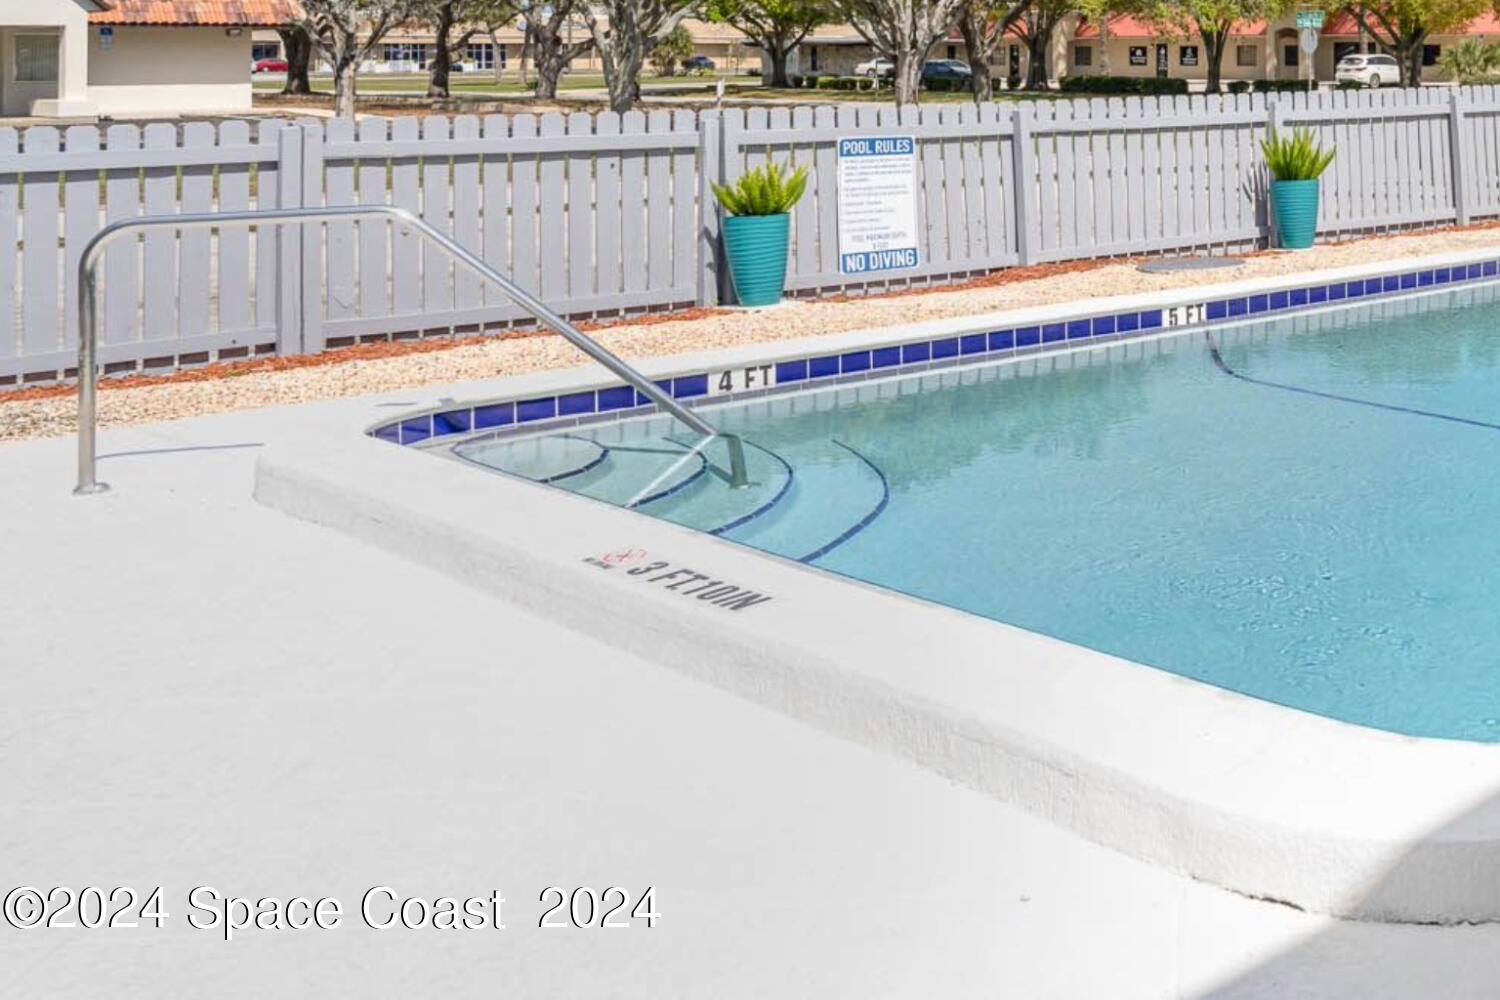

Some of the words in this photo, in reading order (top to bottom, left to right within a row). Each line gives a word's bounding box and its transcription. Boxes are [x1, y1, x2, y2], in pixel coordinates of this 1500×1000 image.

[843, 141, 873, 155] POOL
[875, 140, 911, 153] RULES
[846, 254, 866, 272] NO
[869, 249, 915, 270] DIVING
[1169, 307, 1178, 326] 5
[1186, 303, 1204, 325] FT
[718, 370, 733, 391] 4
[745, 364, 772, 389] FT
[626, 561, 670, 575] 3
